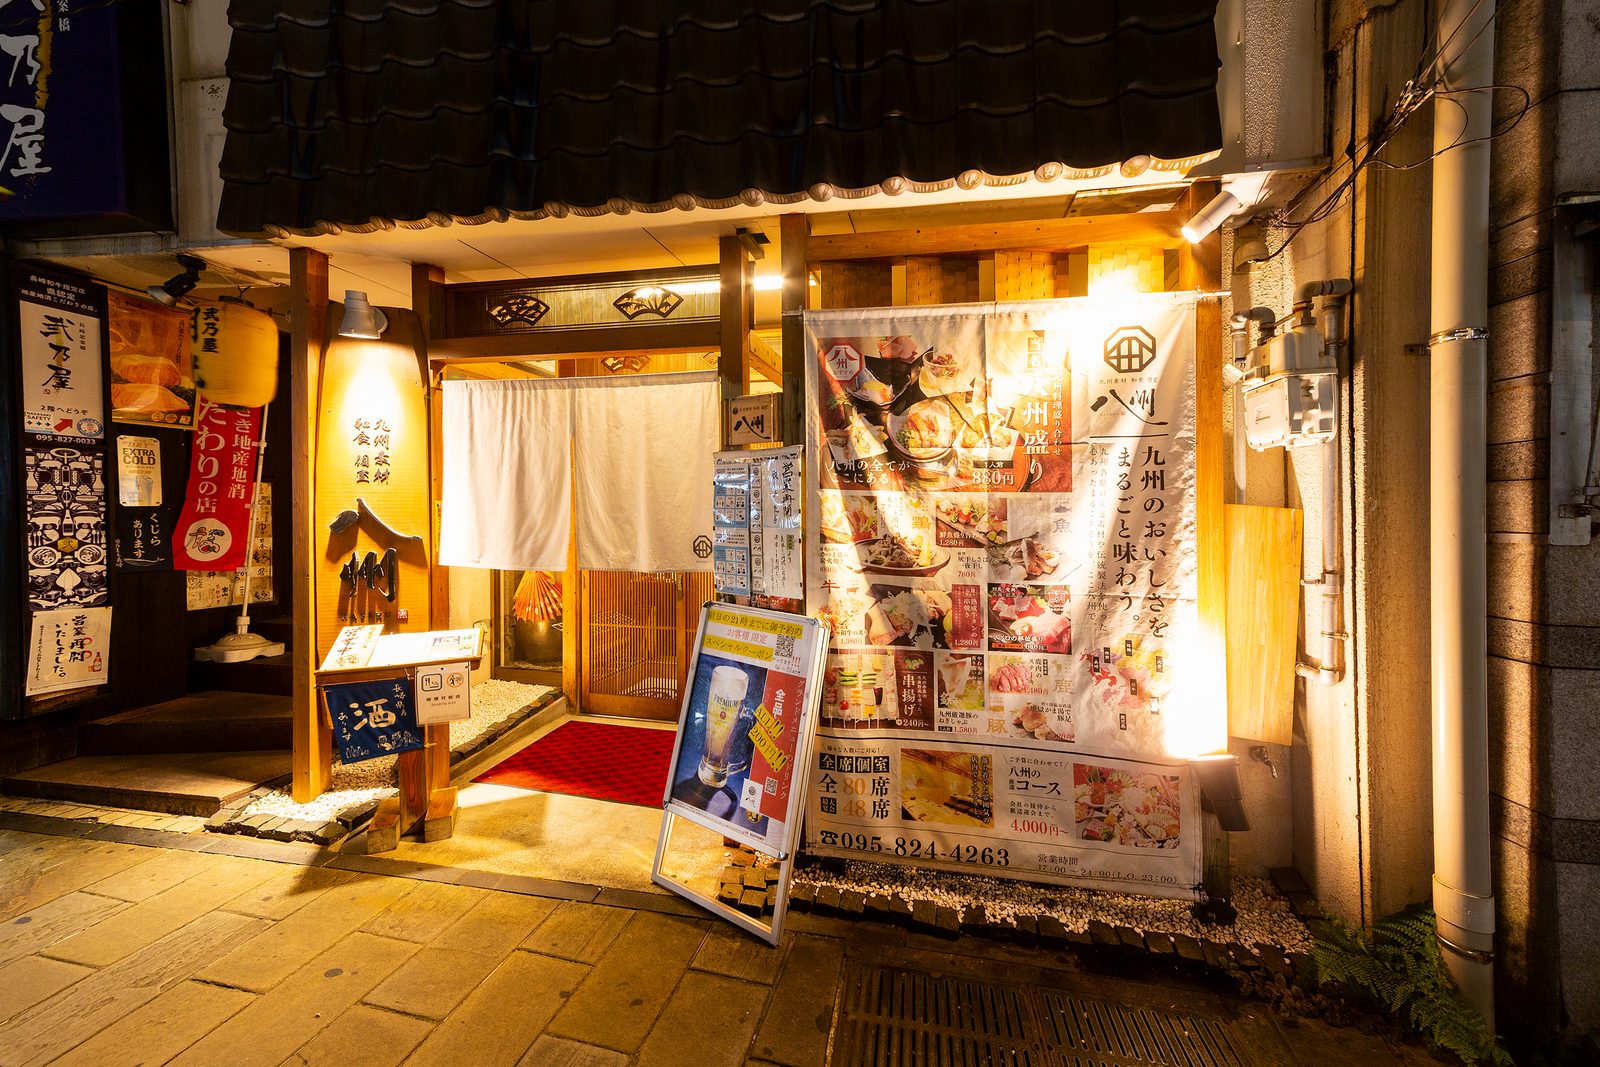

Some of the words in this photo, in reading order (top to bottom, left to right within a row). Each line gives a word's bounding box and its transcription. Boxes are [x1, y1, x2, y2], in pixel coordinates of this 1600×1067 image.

[0, 0, 52, 178] 乃屋
[1090, 388, 1169, 425] 八州
[123, 448, 155, 456] EXTRA
[123, 456, 156, 465] COLD
[972, 470, 1015, 486] 880円
[150, 513, 161, 546] くじら
[1053, 518, 1072, 533] 魚
[1113, 447, 1140, 622] まるごと味わう。
[133, 520, 145, 558] あります
[1140, 446, 1169, 638] 九州のおいしさを
[821, 580, 841, 594] 牛
[902, 674, 916, 718] 串揚げ
[349, 698, 396, 731] 酒
[986, 718, 1008, 733] 豚
[820, 754, 889, 773] 全席個室
[1008, 766, 1041, 779] 八州の
[1016, 780, 1061, 796] コース
[841, 832, 1010, 867] 095-824-4263
[1038, 853, 1079, 866] 営業時間
